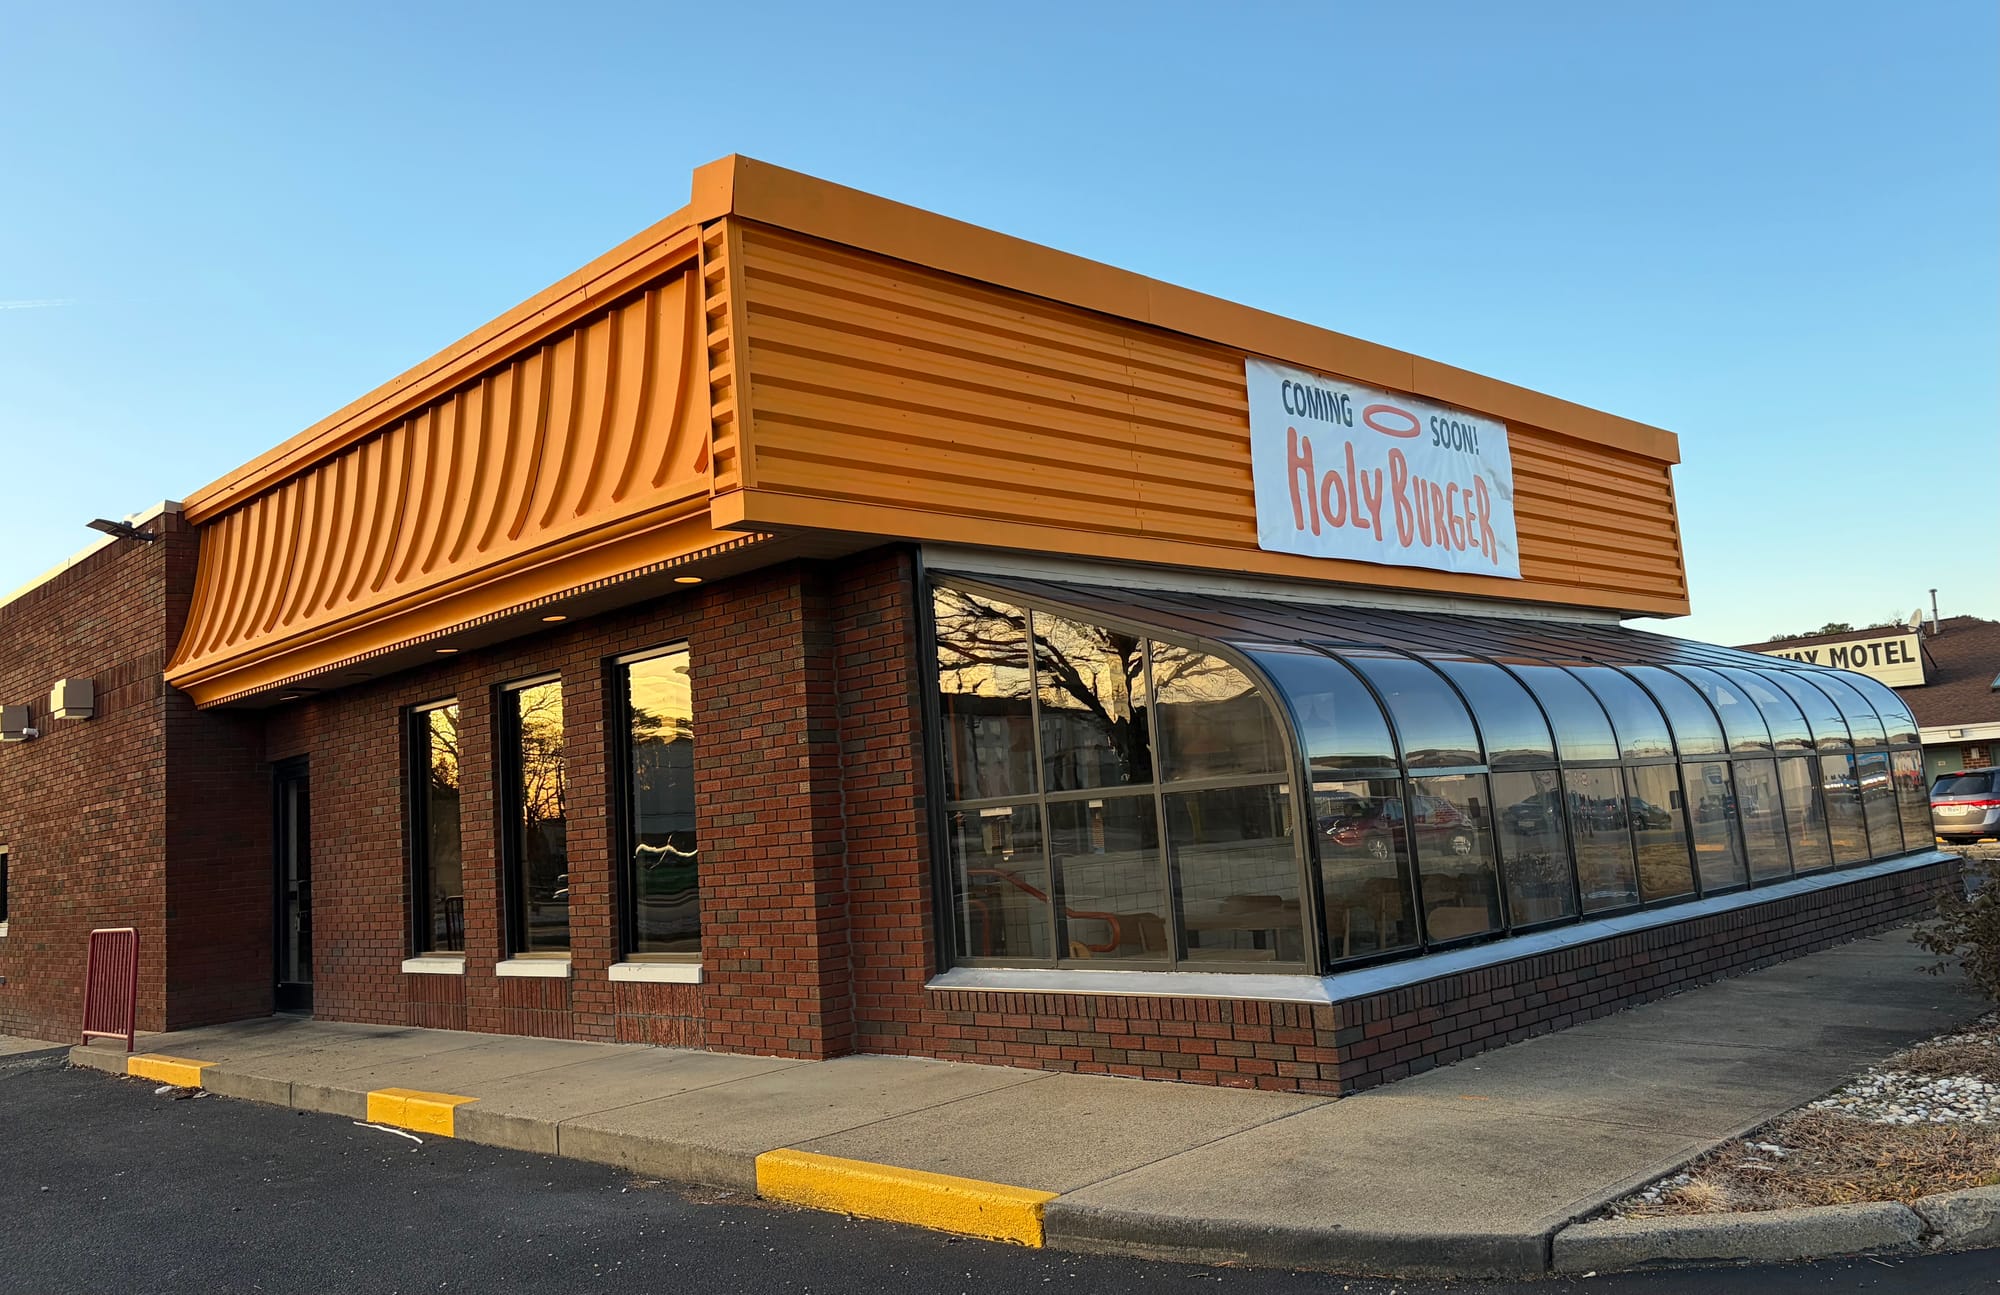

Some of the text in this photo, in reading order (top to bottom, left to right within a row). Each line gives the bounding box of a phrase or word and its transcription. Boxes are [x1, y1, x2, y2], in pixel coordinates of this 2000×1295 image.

[1281, 379, 1480, 455] COMING SOON!
[1388, 447, 1498, 566] BURGER
[1829, 640, 1916, 669] MOTEL
